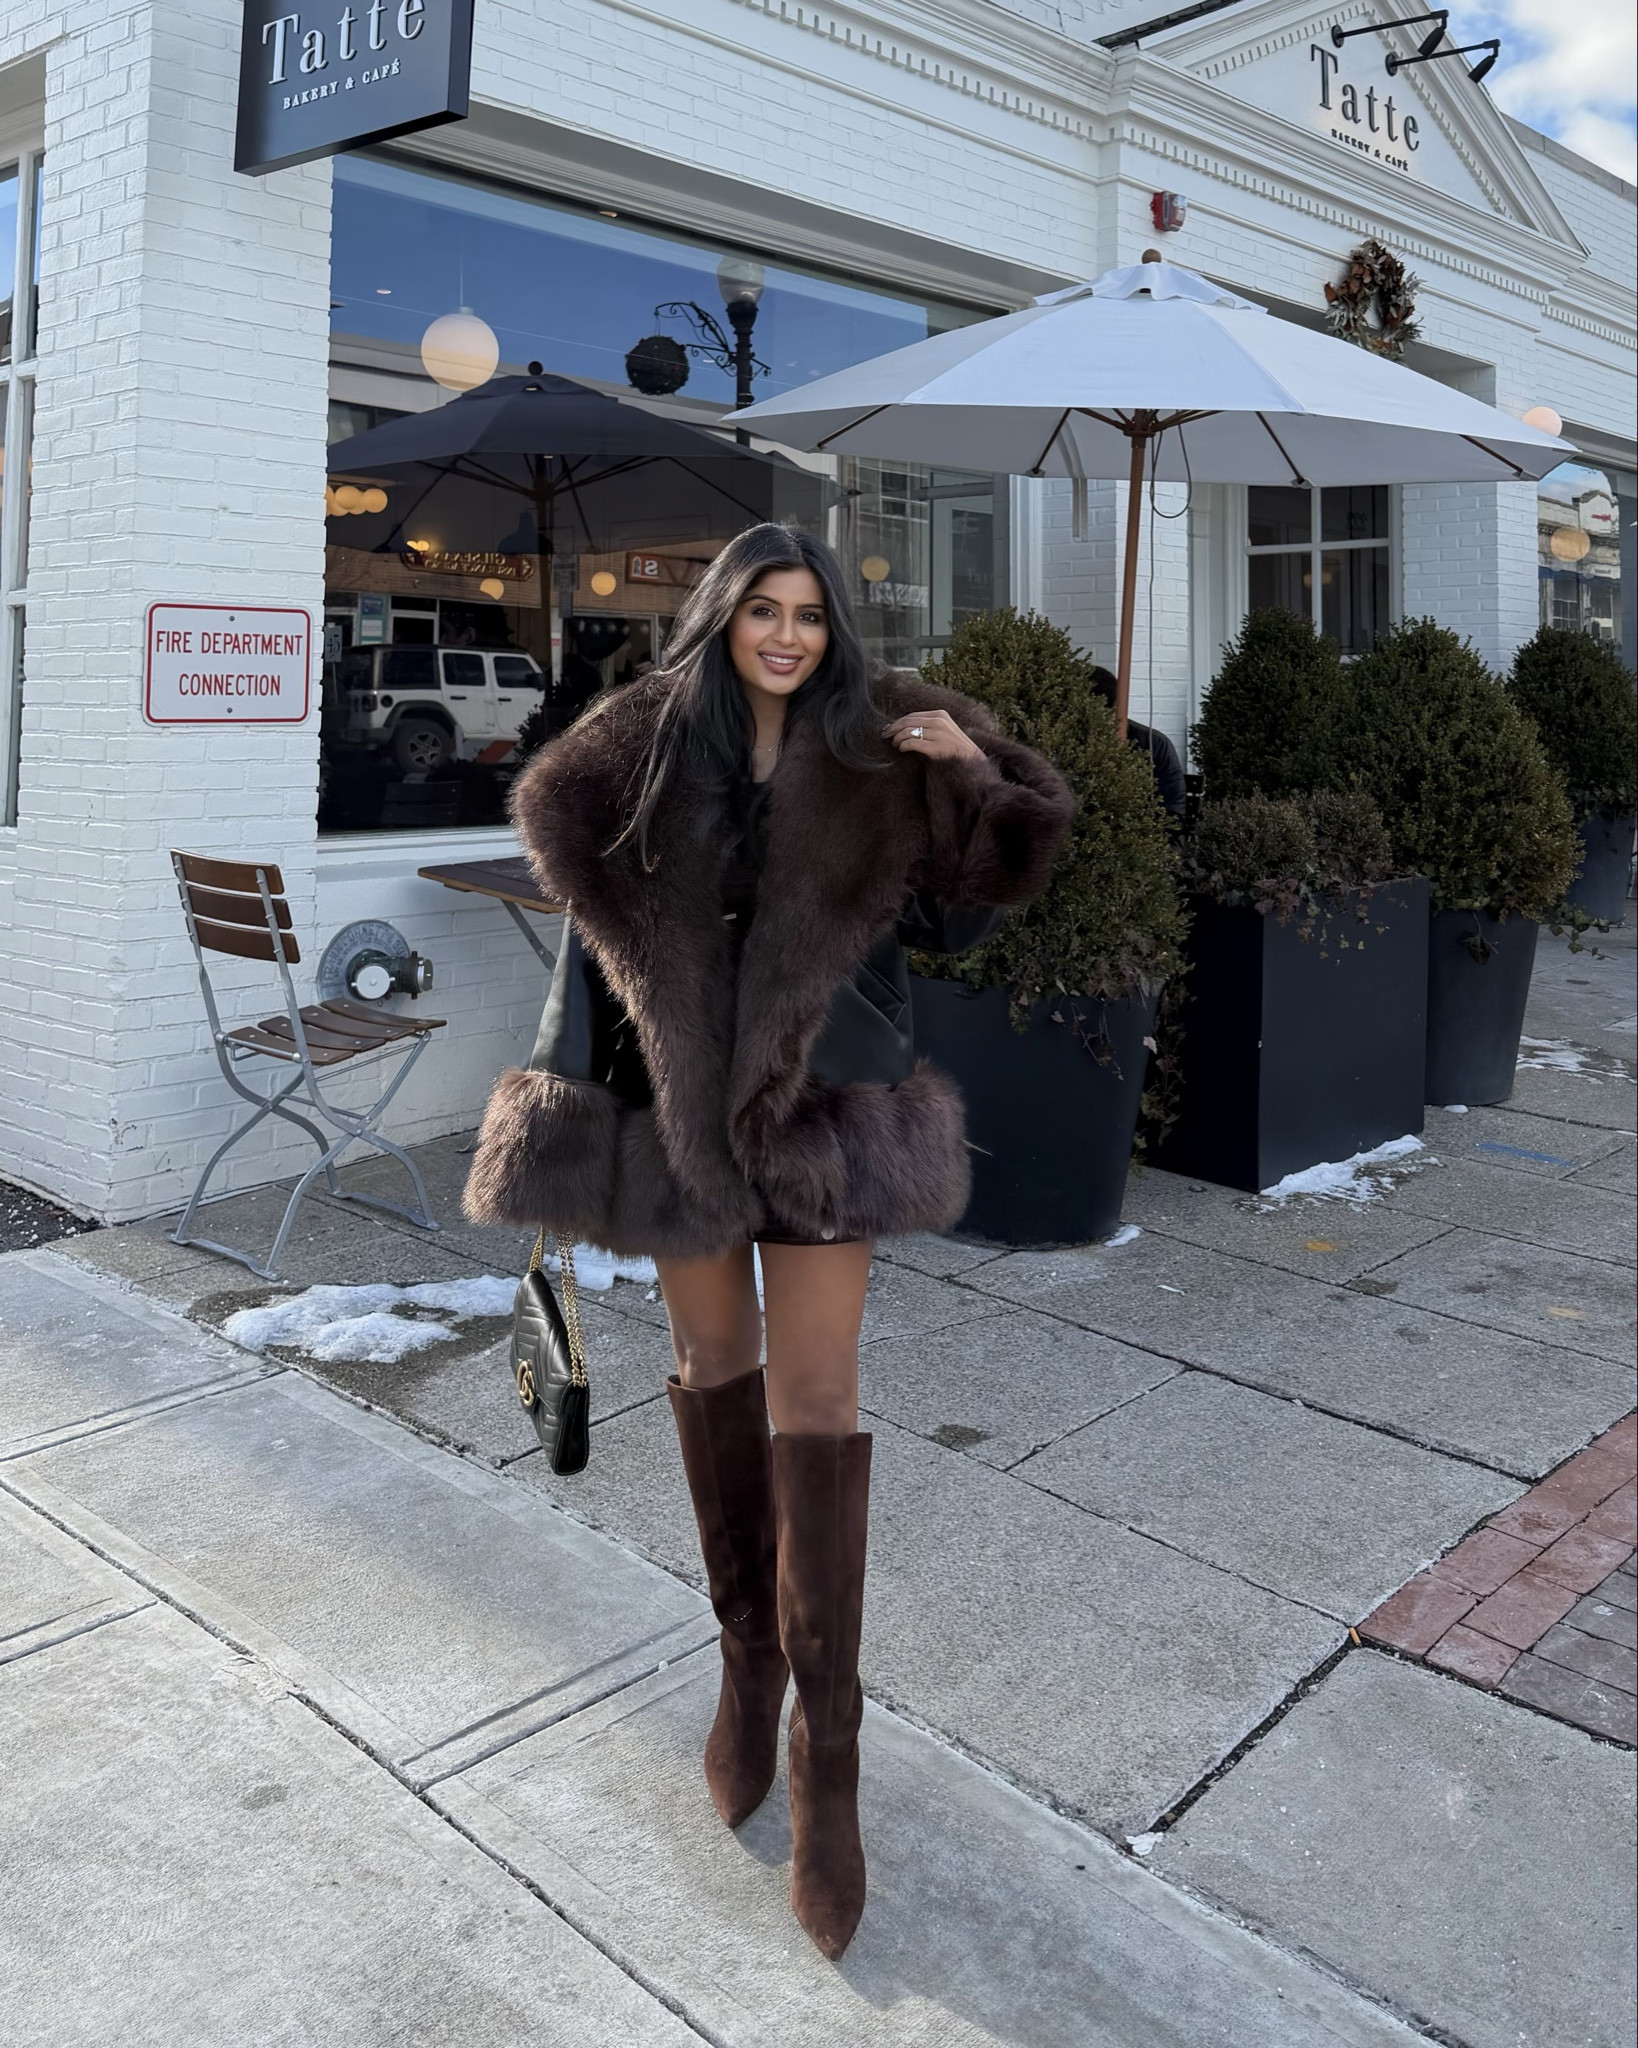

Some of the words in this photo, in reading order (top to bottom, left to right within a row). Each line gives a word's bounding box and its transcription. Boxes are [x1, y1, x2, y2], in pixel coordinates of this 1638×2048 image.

[262, 0, 425, 85] Tatte
[283, 81, 339, 110] BAKERY
[345, 76, 355, 90] &
[362, 58, 401, 84] CAFÉ
[1311, 43, 1420, 152] Tatte
[1331, 128, 1370, 153] BAKERY
[1374, 149, 1382, 158] &
[1385, 154, 1409, 172] CAFÉ
[156, 630, 193, 654] FIRE
[201, 632, 303, 656] DEPARTMENT
[179, 673, 281, 696] CONNECTION
